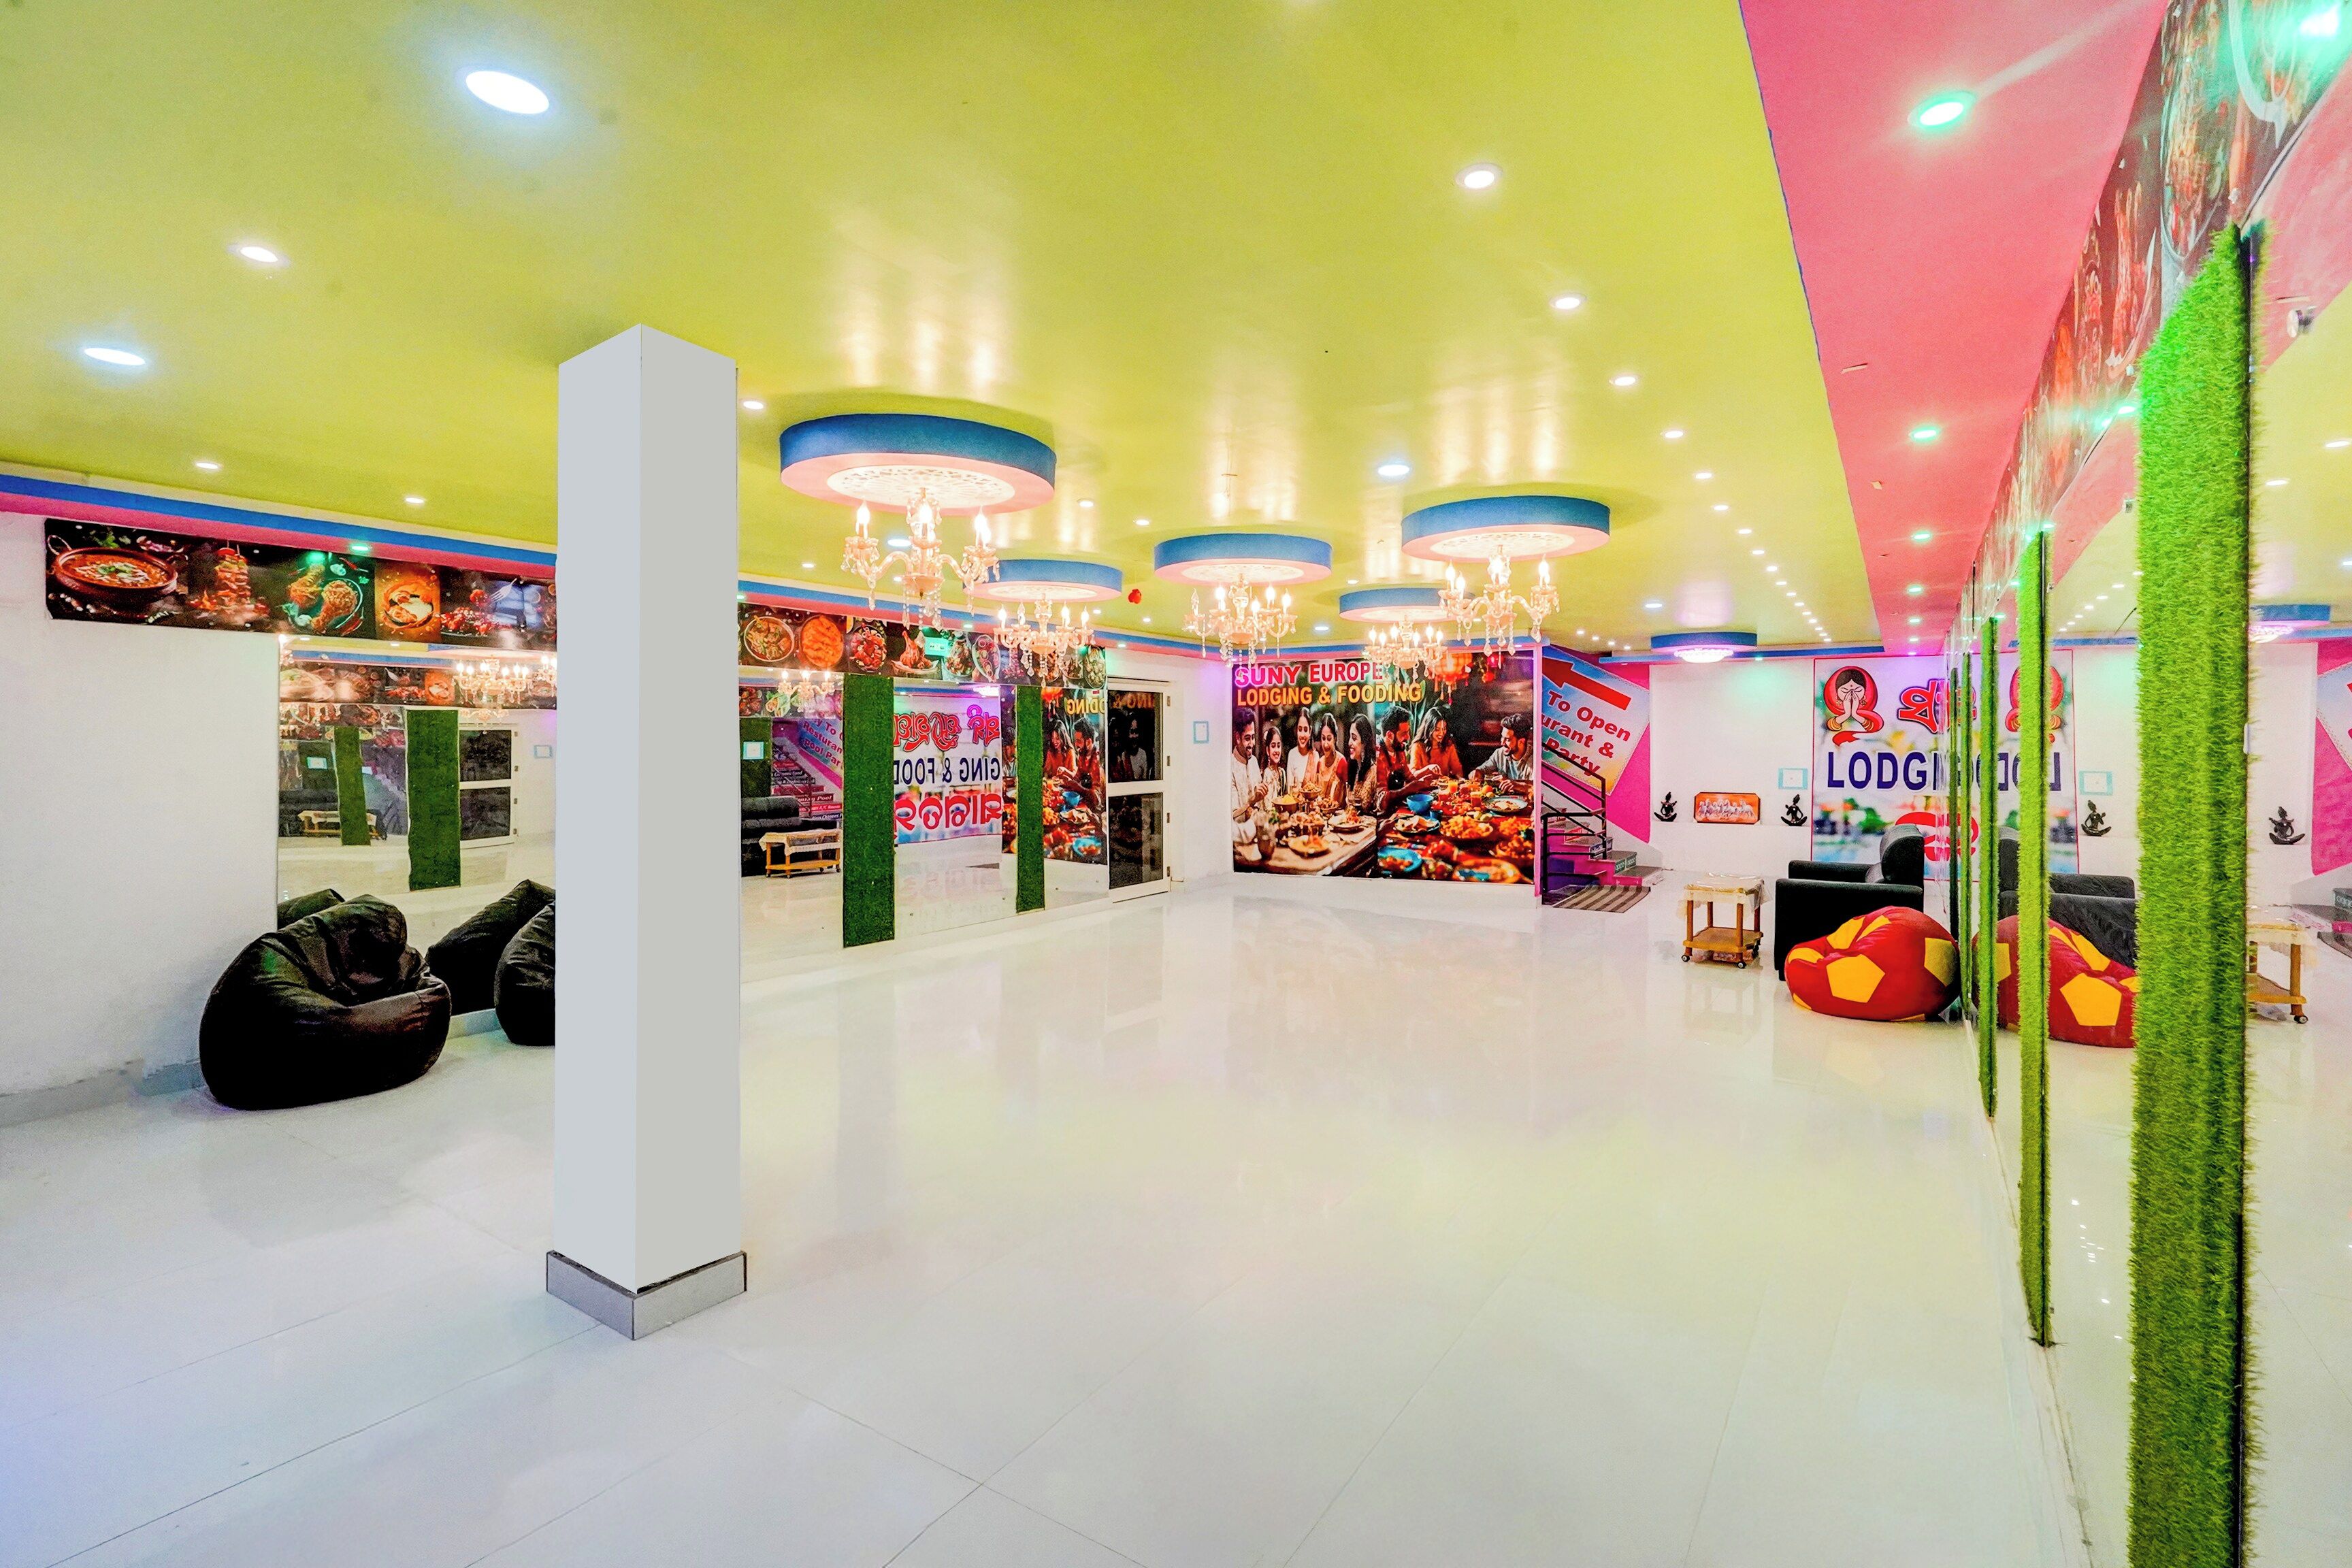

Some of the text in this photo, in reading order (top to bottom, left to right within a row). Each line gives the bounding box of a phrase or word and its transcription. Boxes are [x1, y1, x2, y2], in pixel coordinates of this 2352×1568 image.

[1235, 662, 1383, 686] SUNY EUROPE
[1237, 683, 1422, 706] LODGING & FOODING
[1548, 690, 1631, 742] To Open
[1599, 742, 1614, 759] &
